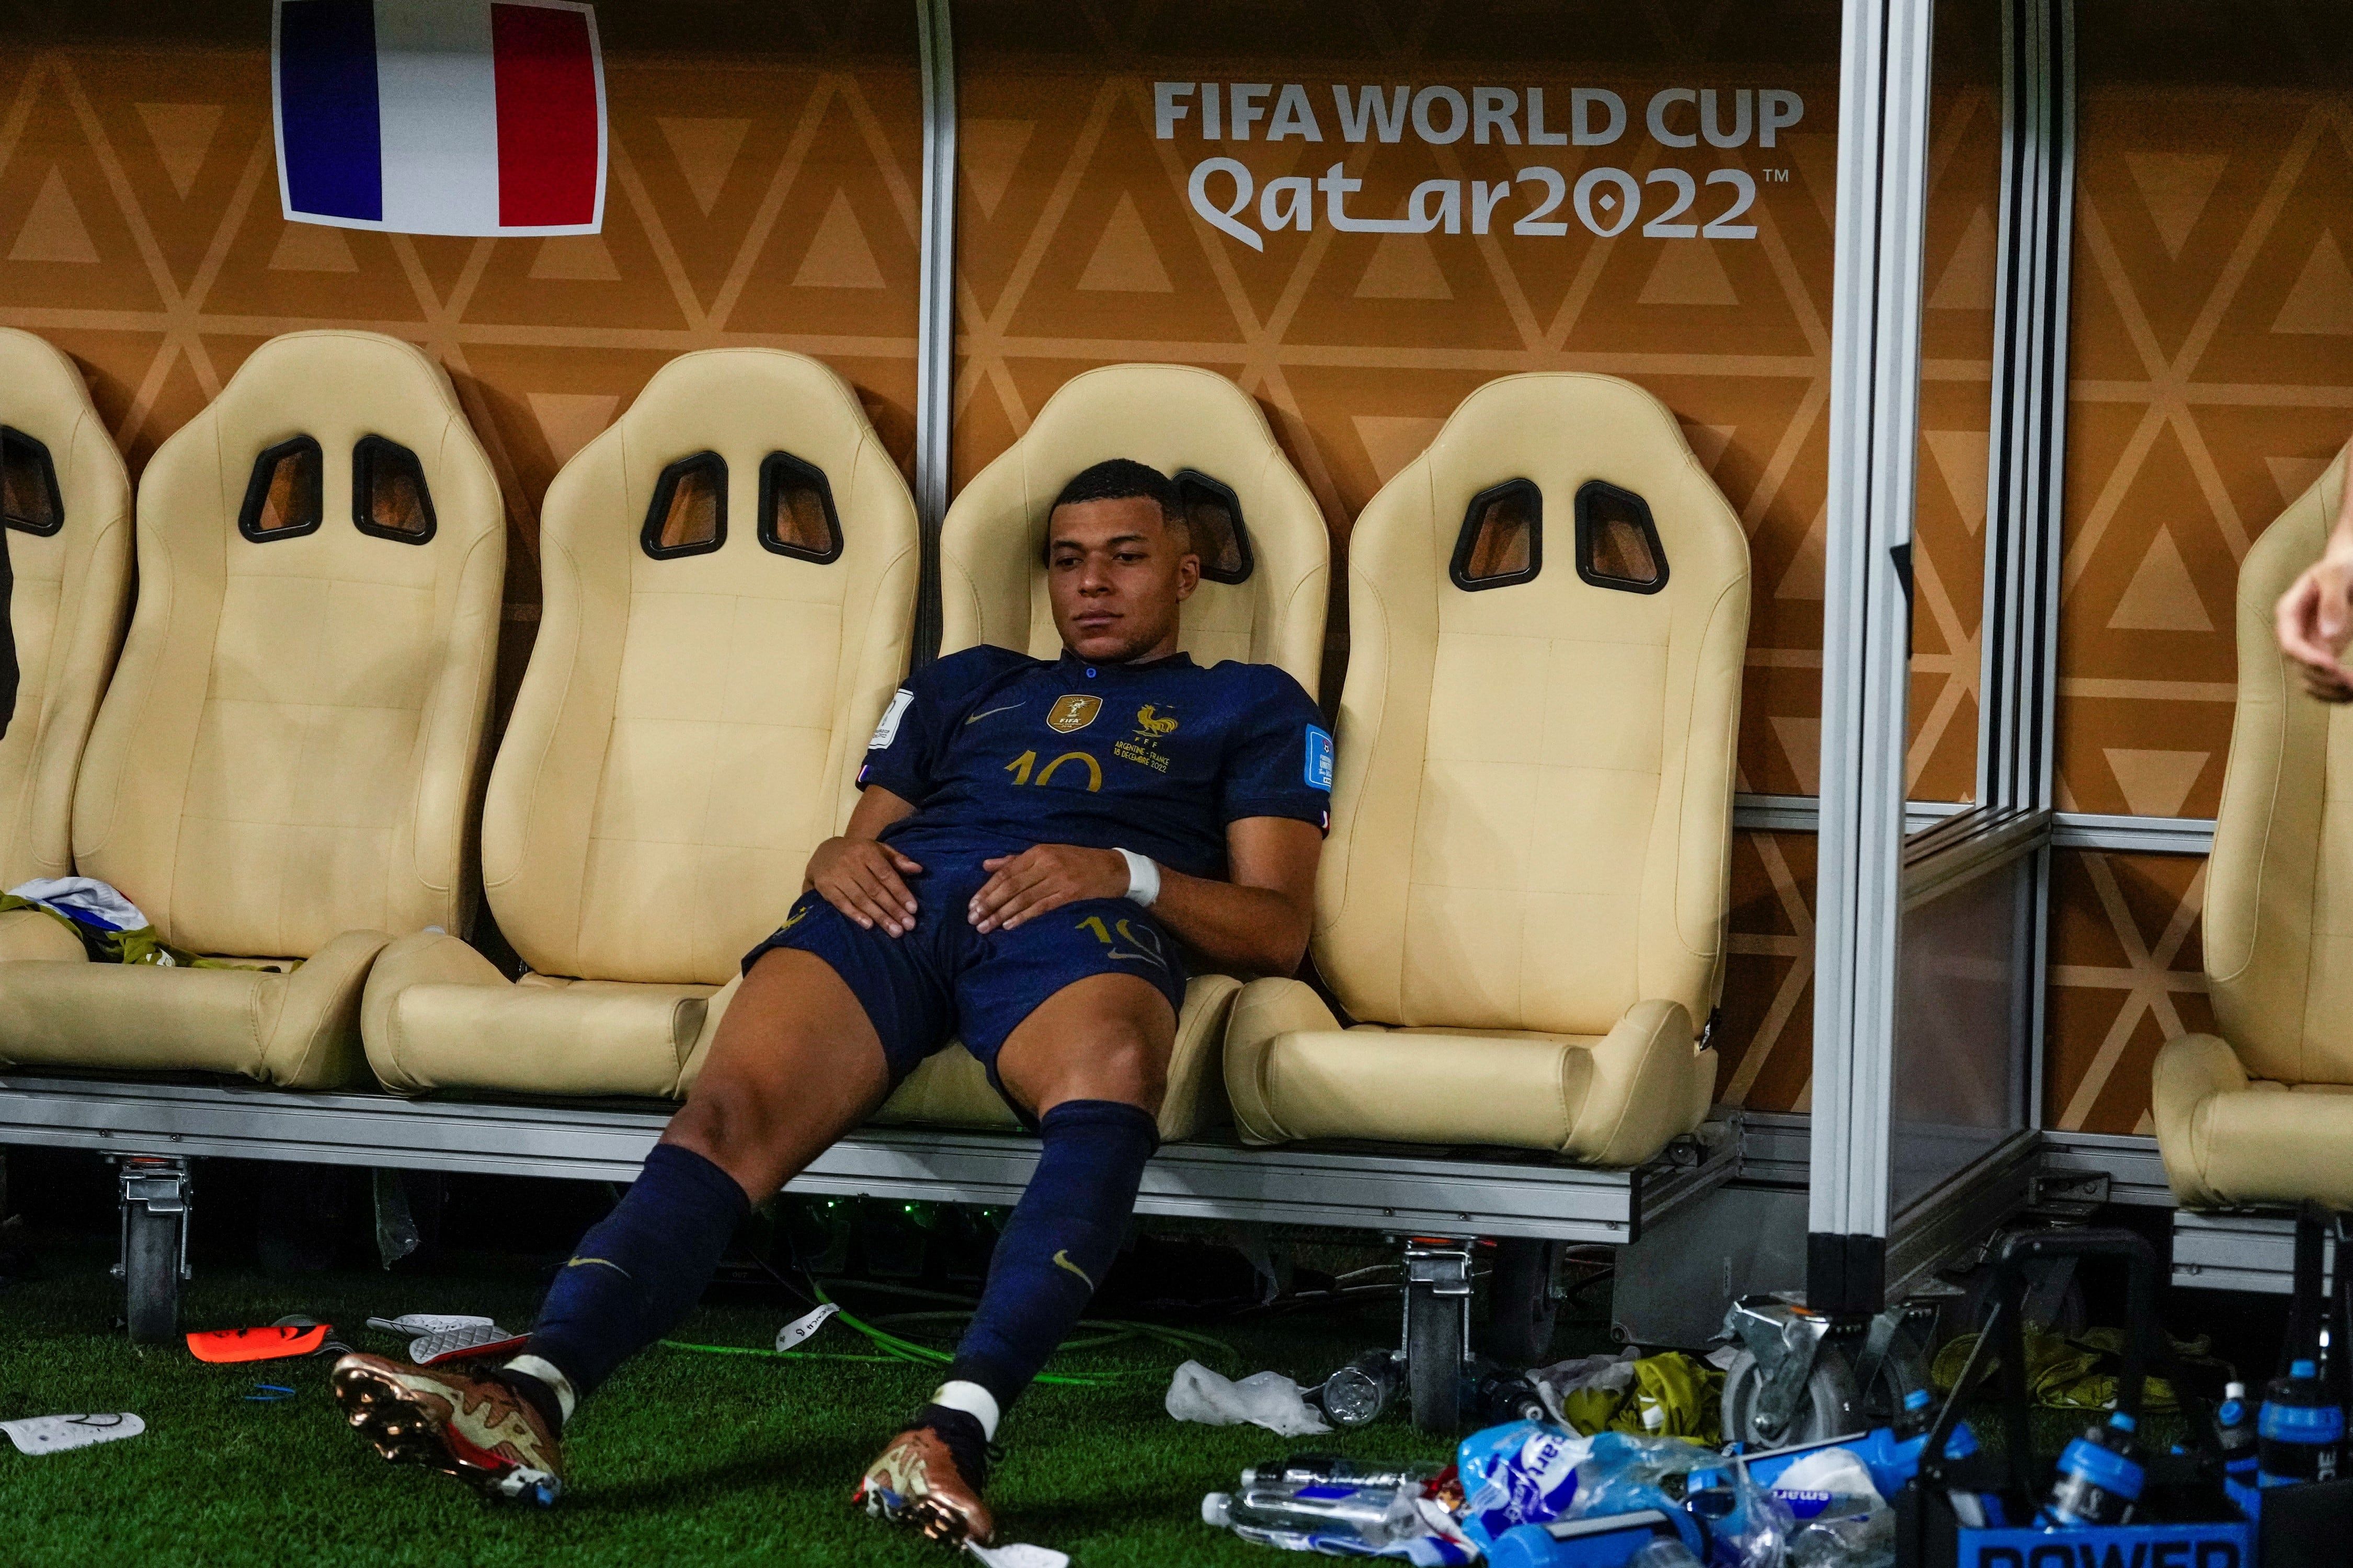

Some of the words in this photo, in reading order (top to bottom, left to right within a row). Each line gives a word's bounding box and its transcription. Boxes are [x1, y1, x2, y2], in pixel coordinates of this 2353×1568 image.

[1154, 82, 1323, 142] FIFA
[1332, 85, 1627, 146] WORLD
[1646, 88, 1804, 148] CUP
[1114, 740, 1146, 756] ARGENTINE
[1150, 751, 1170, 765] FRANCE
[1150, 760, 1167, 773] 2022
